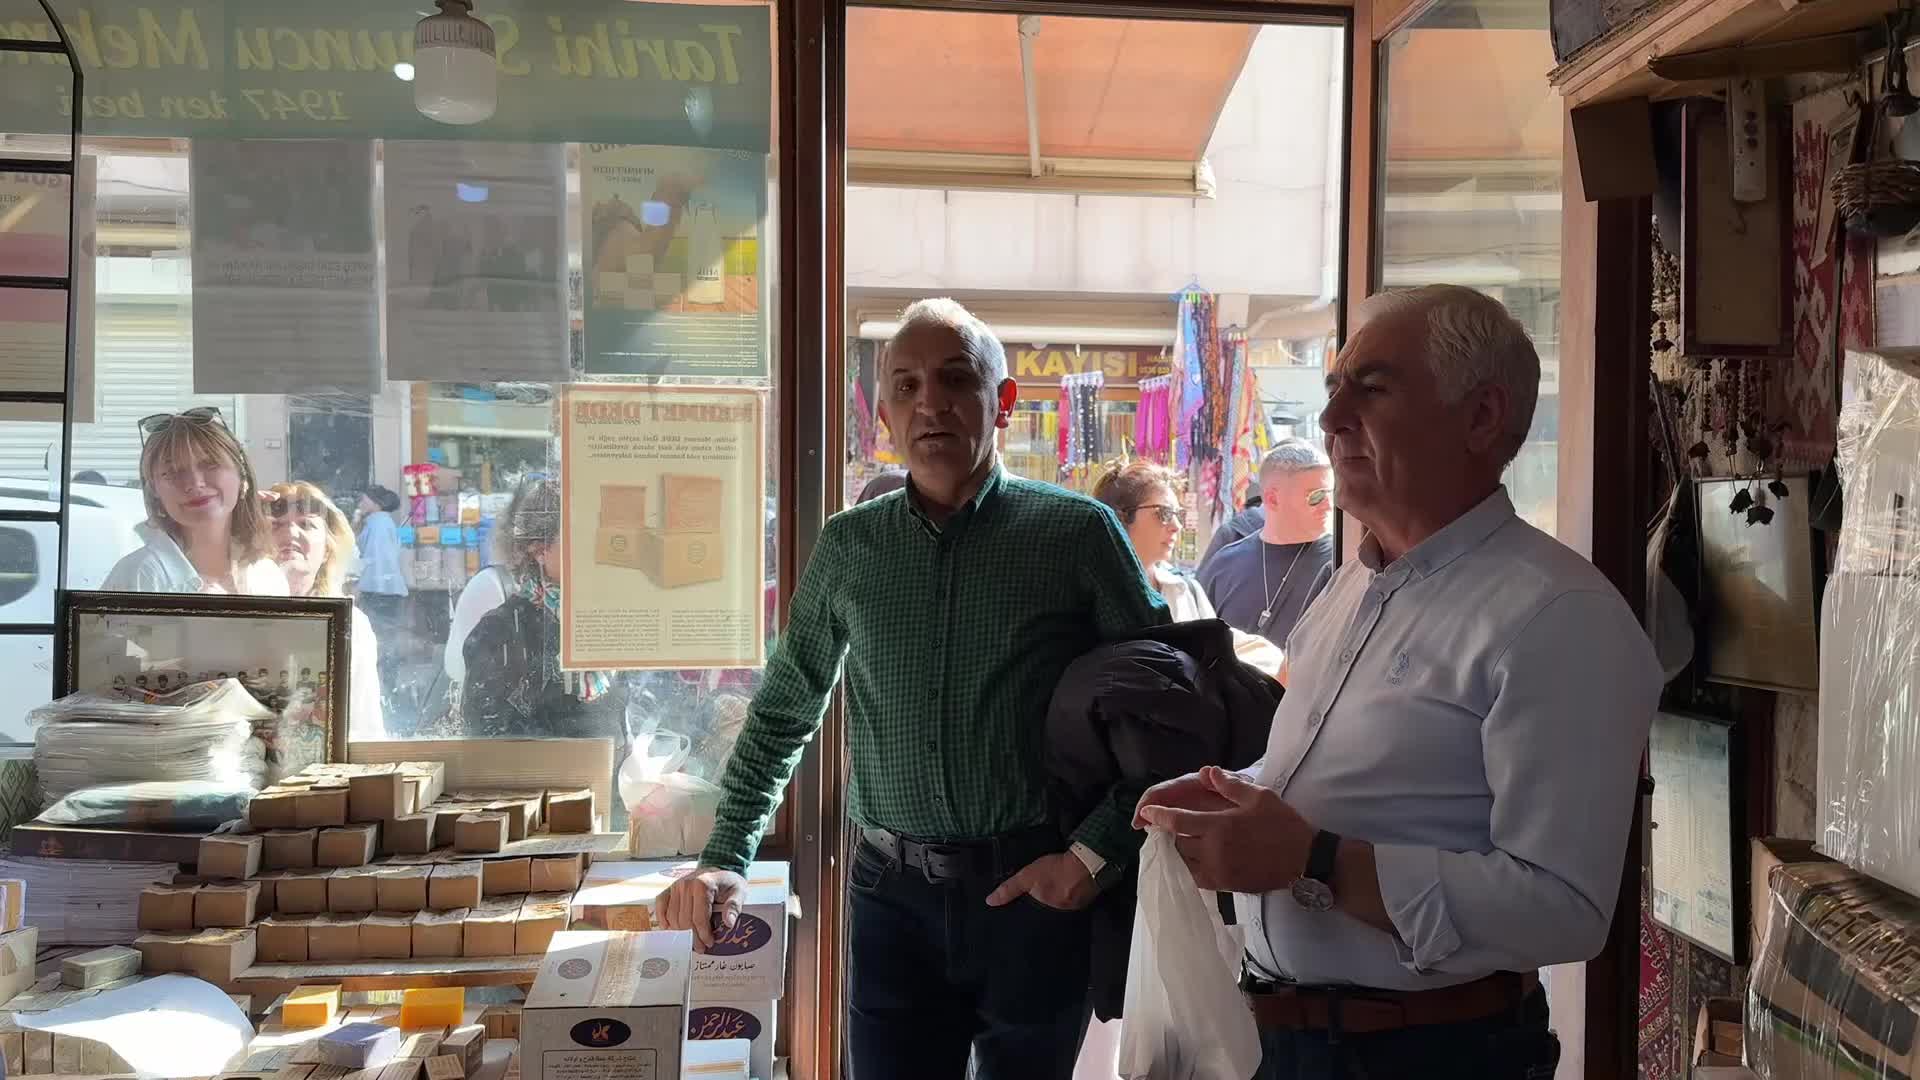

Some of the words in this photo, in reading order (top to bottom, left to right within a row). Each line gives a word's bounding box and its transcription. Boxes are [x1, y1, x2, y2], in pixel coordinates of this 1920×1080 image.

[1016, 351, 1137, 377] KAYISI
[694, 960, 715, 972] ممتاز
[714, 960, 728, 971] غار
[731, 961, 756, 971] صابون
